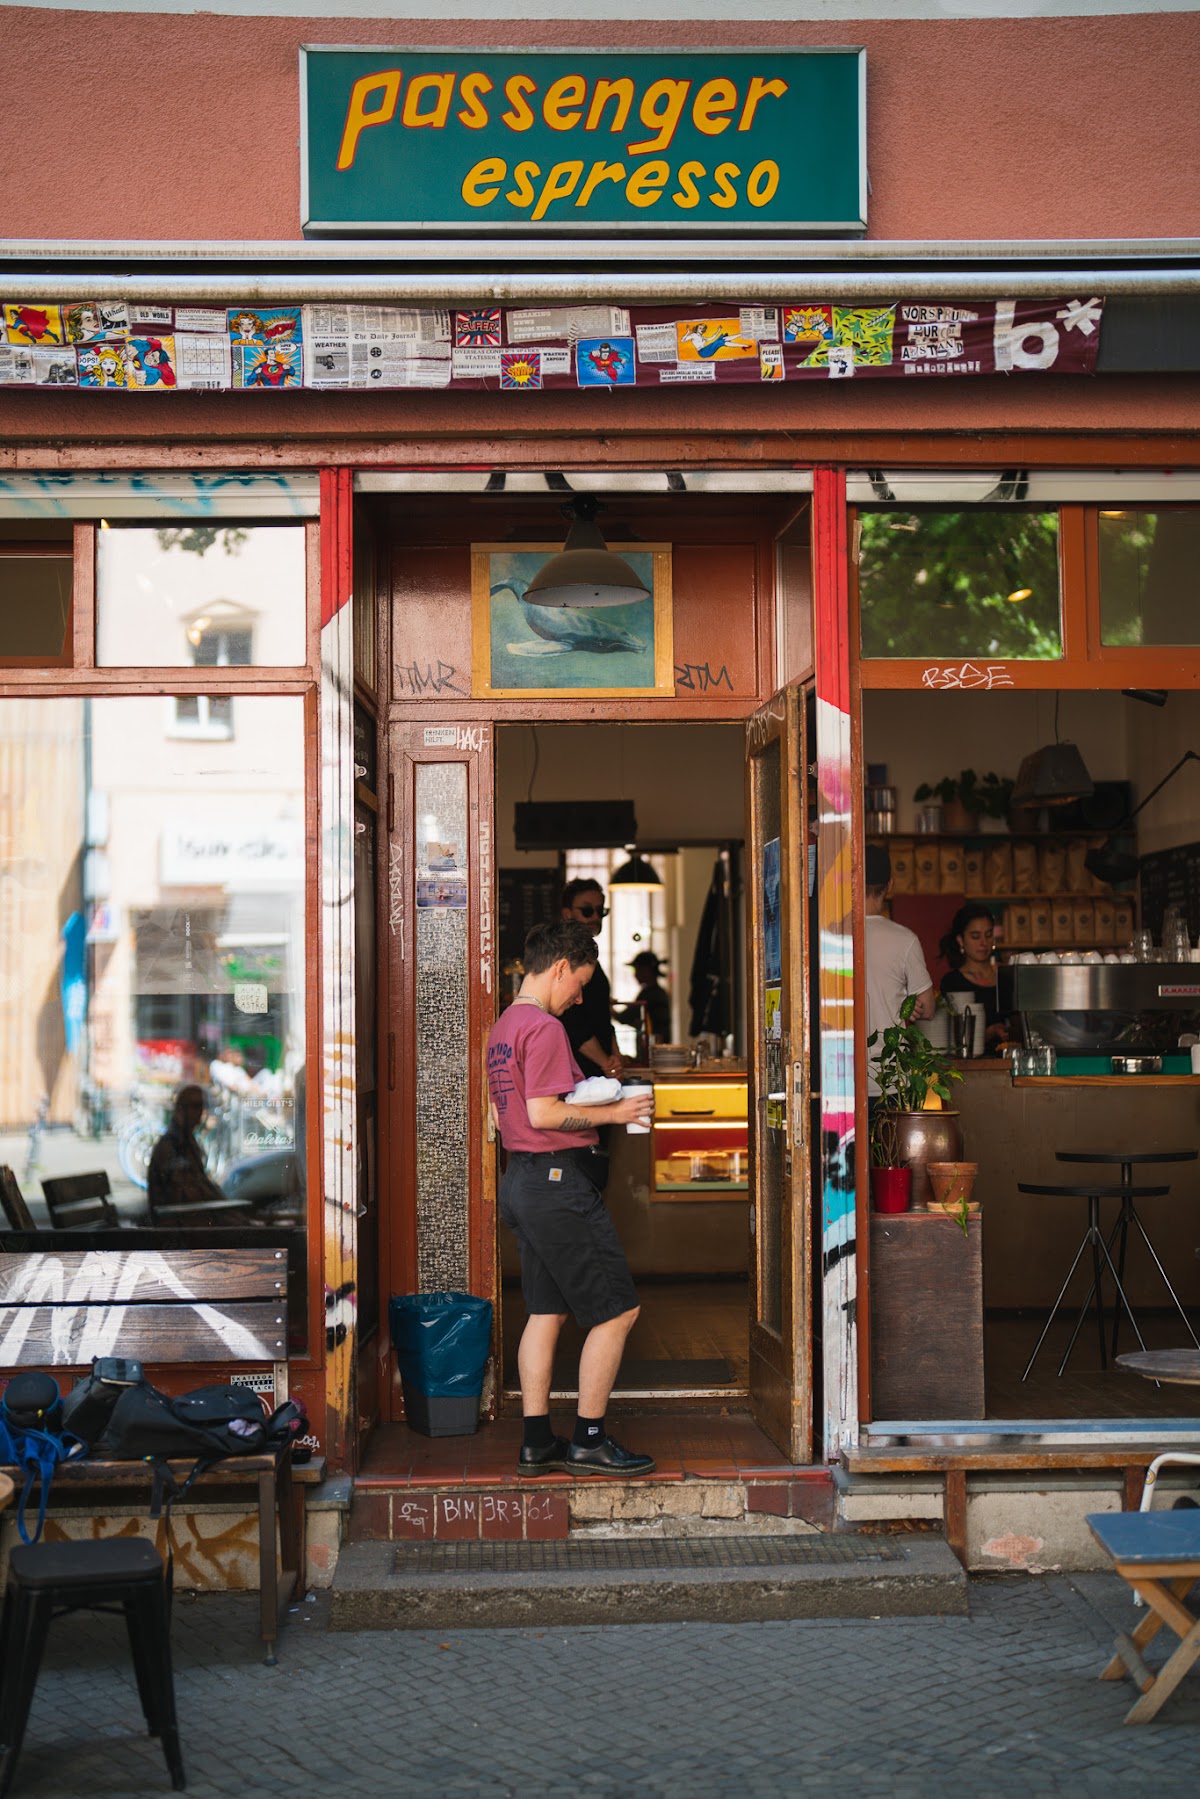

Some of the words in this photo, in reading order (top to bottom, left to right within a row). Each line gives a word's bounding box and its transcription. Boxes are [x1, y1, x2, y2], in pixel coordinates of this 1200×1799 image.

[460, 156, 779, 221] espresso
[105, 305, 125, 318] What?
[264, 321, 296, 339] WOW!
[460, 320, 496, 332] SUPER
[391, 332, 416, 340] Journal
[507, 366, 537, 377] SNAP!
[243, 1132, 294, 1145] Paletas
